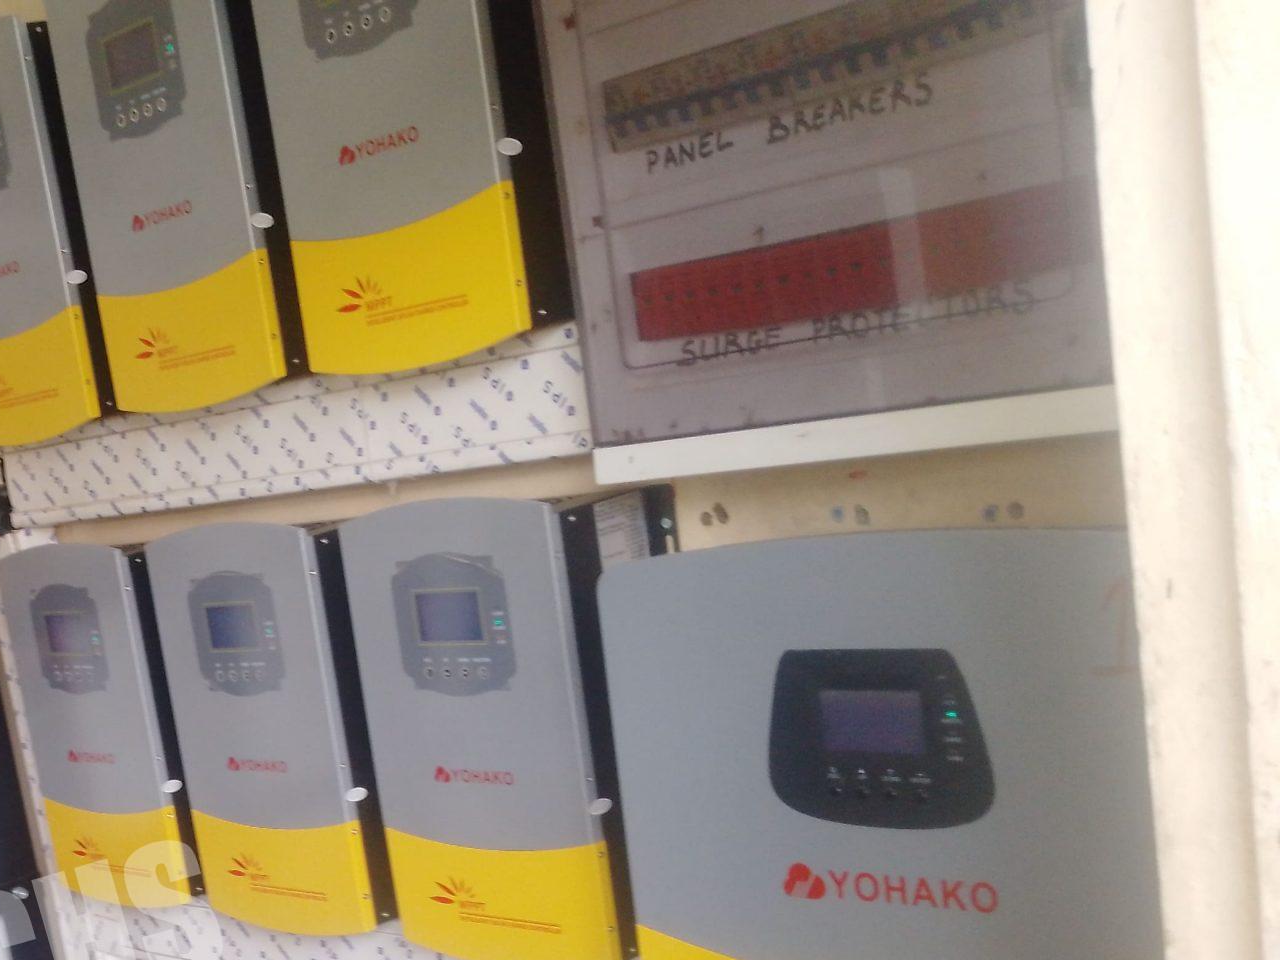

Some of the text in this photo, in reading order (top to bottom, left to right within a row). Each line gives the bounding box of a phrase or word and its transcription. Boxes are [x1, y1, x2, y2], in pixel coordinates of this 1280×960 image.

[645, 75, 934, 173] PANEL BREAKERS
[355, 126, 419, 156] YOHAKO
[144, 200, 192, 224] YOHAKO
[677, 280, 1036, 367] SURGE PROTETORS
[239, 758, 287, 773] YOHAKO
[451, 768, 515, 786] YOHAKO
[828, 869, 999, 914] YOHAKO
